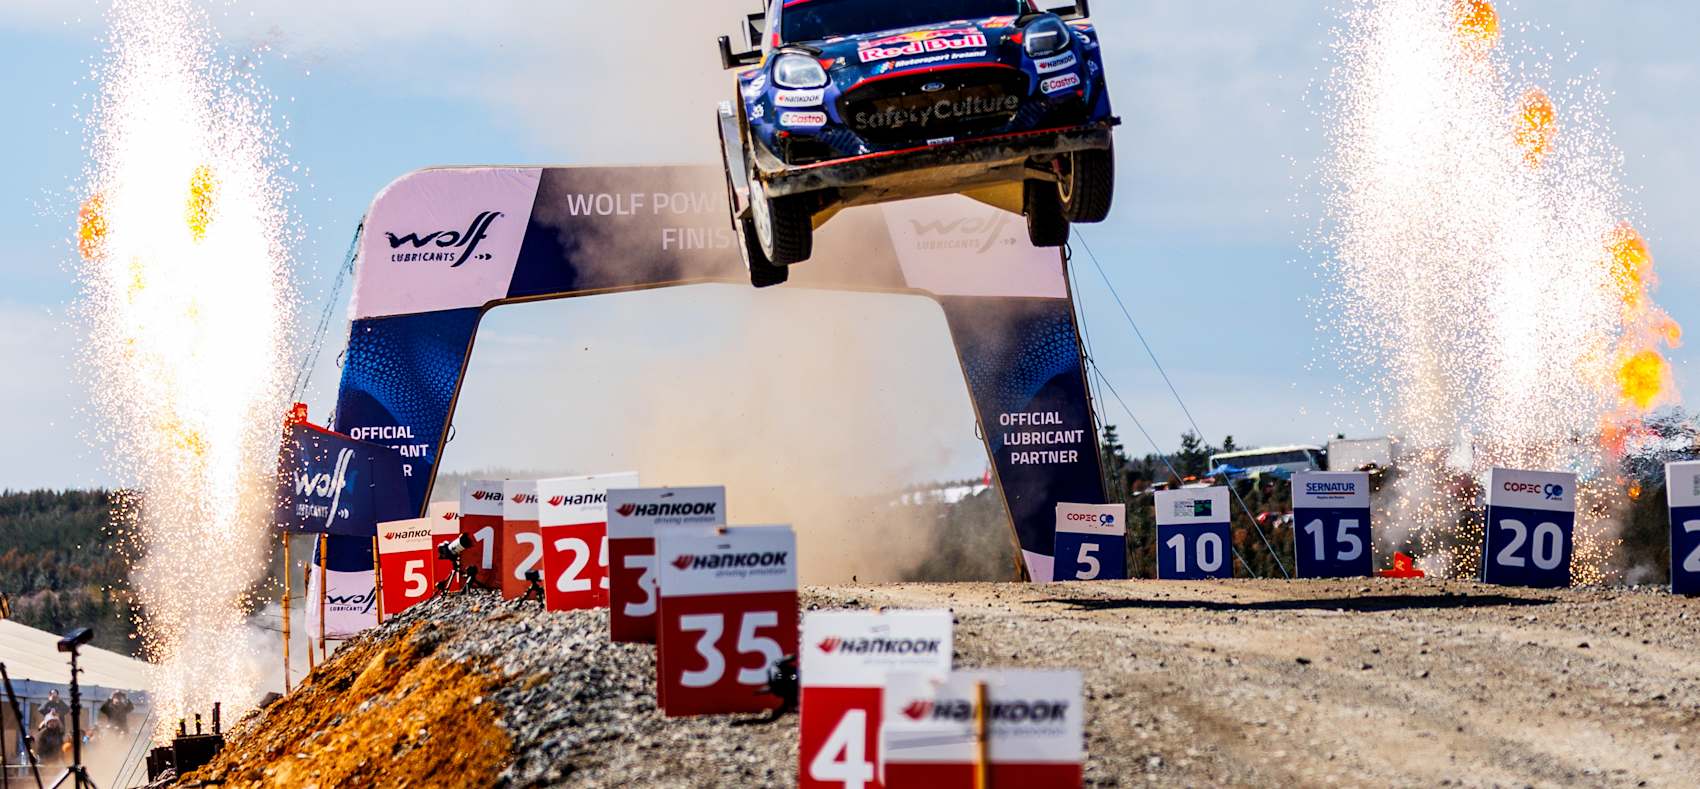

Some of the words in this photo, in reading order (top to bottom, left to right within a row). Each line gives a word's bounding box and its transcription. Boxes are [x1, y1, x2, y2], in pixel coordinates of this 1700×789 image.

[858, 41, 924, 62] Red
[924, 35, 987, 52] Bull
[895, 54, 950, 68] Motorsport
[951, 50, 986, 60] Ireland
[1049, 74, 1079, 89] Castrol
[791, 115, 824, 123] Castrol
[855, 95, 1019, 129] SafetyCulture
[567, 194, 645, 216] WOLF
[653, 192, 728, 215] POW
[385, 211, 501, 267] wolf
[662, 228, 730, 250] FINIS
[917, 239, 980, 250] LUBRICANTS
[391, 252, 455, 262] LUBRICANTS
[1000, 411, 1063, 426] OFFICIAL
[350, 426, 415, 440] OFFICIAL
[1003, 430, 1084, 446] LUBRICANT
[1010, 450, 1079, 465] PARTNER
[1306, 482, 1355, 492] SERNATUR
[1503, 481, 1542, 494] COPEC
[1066, 512, 1098, 522] COPEC
[1304, 518, 1363, 561] 15
[1496, 518, 1564, 570] 20
[1075, 542, 1101, 580] 5
[1166, 531, 1223, 573] 10
[404, 559, 428, 597] 5
[679, 610, 785, 687] 35
